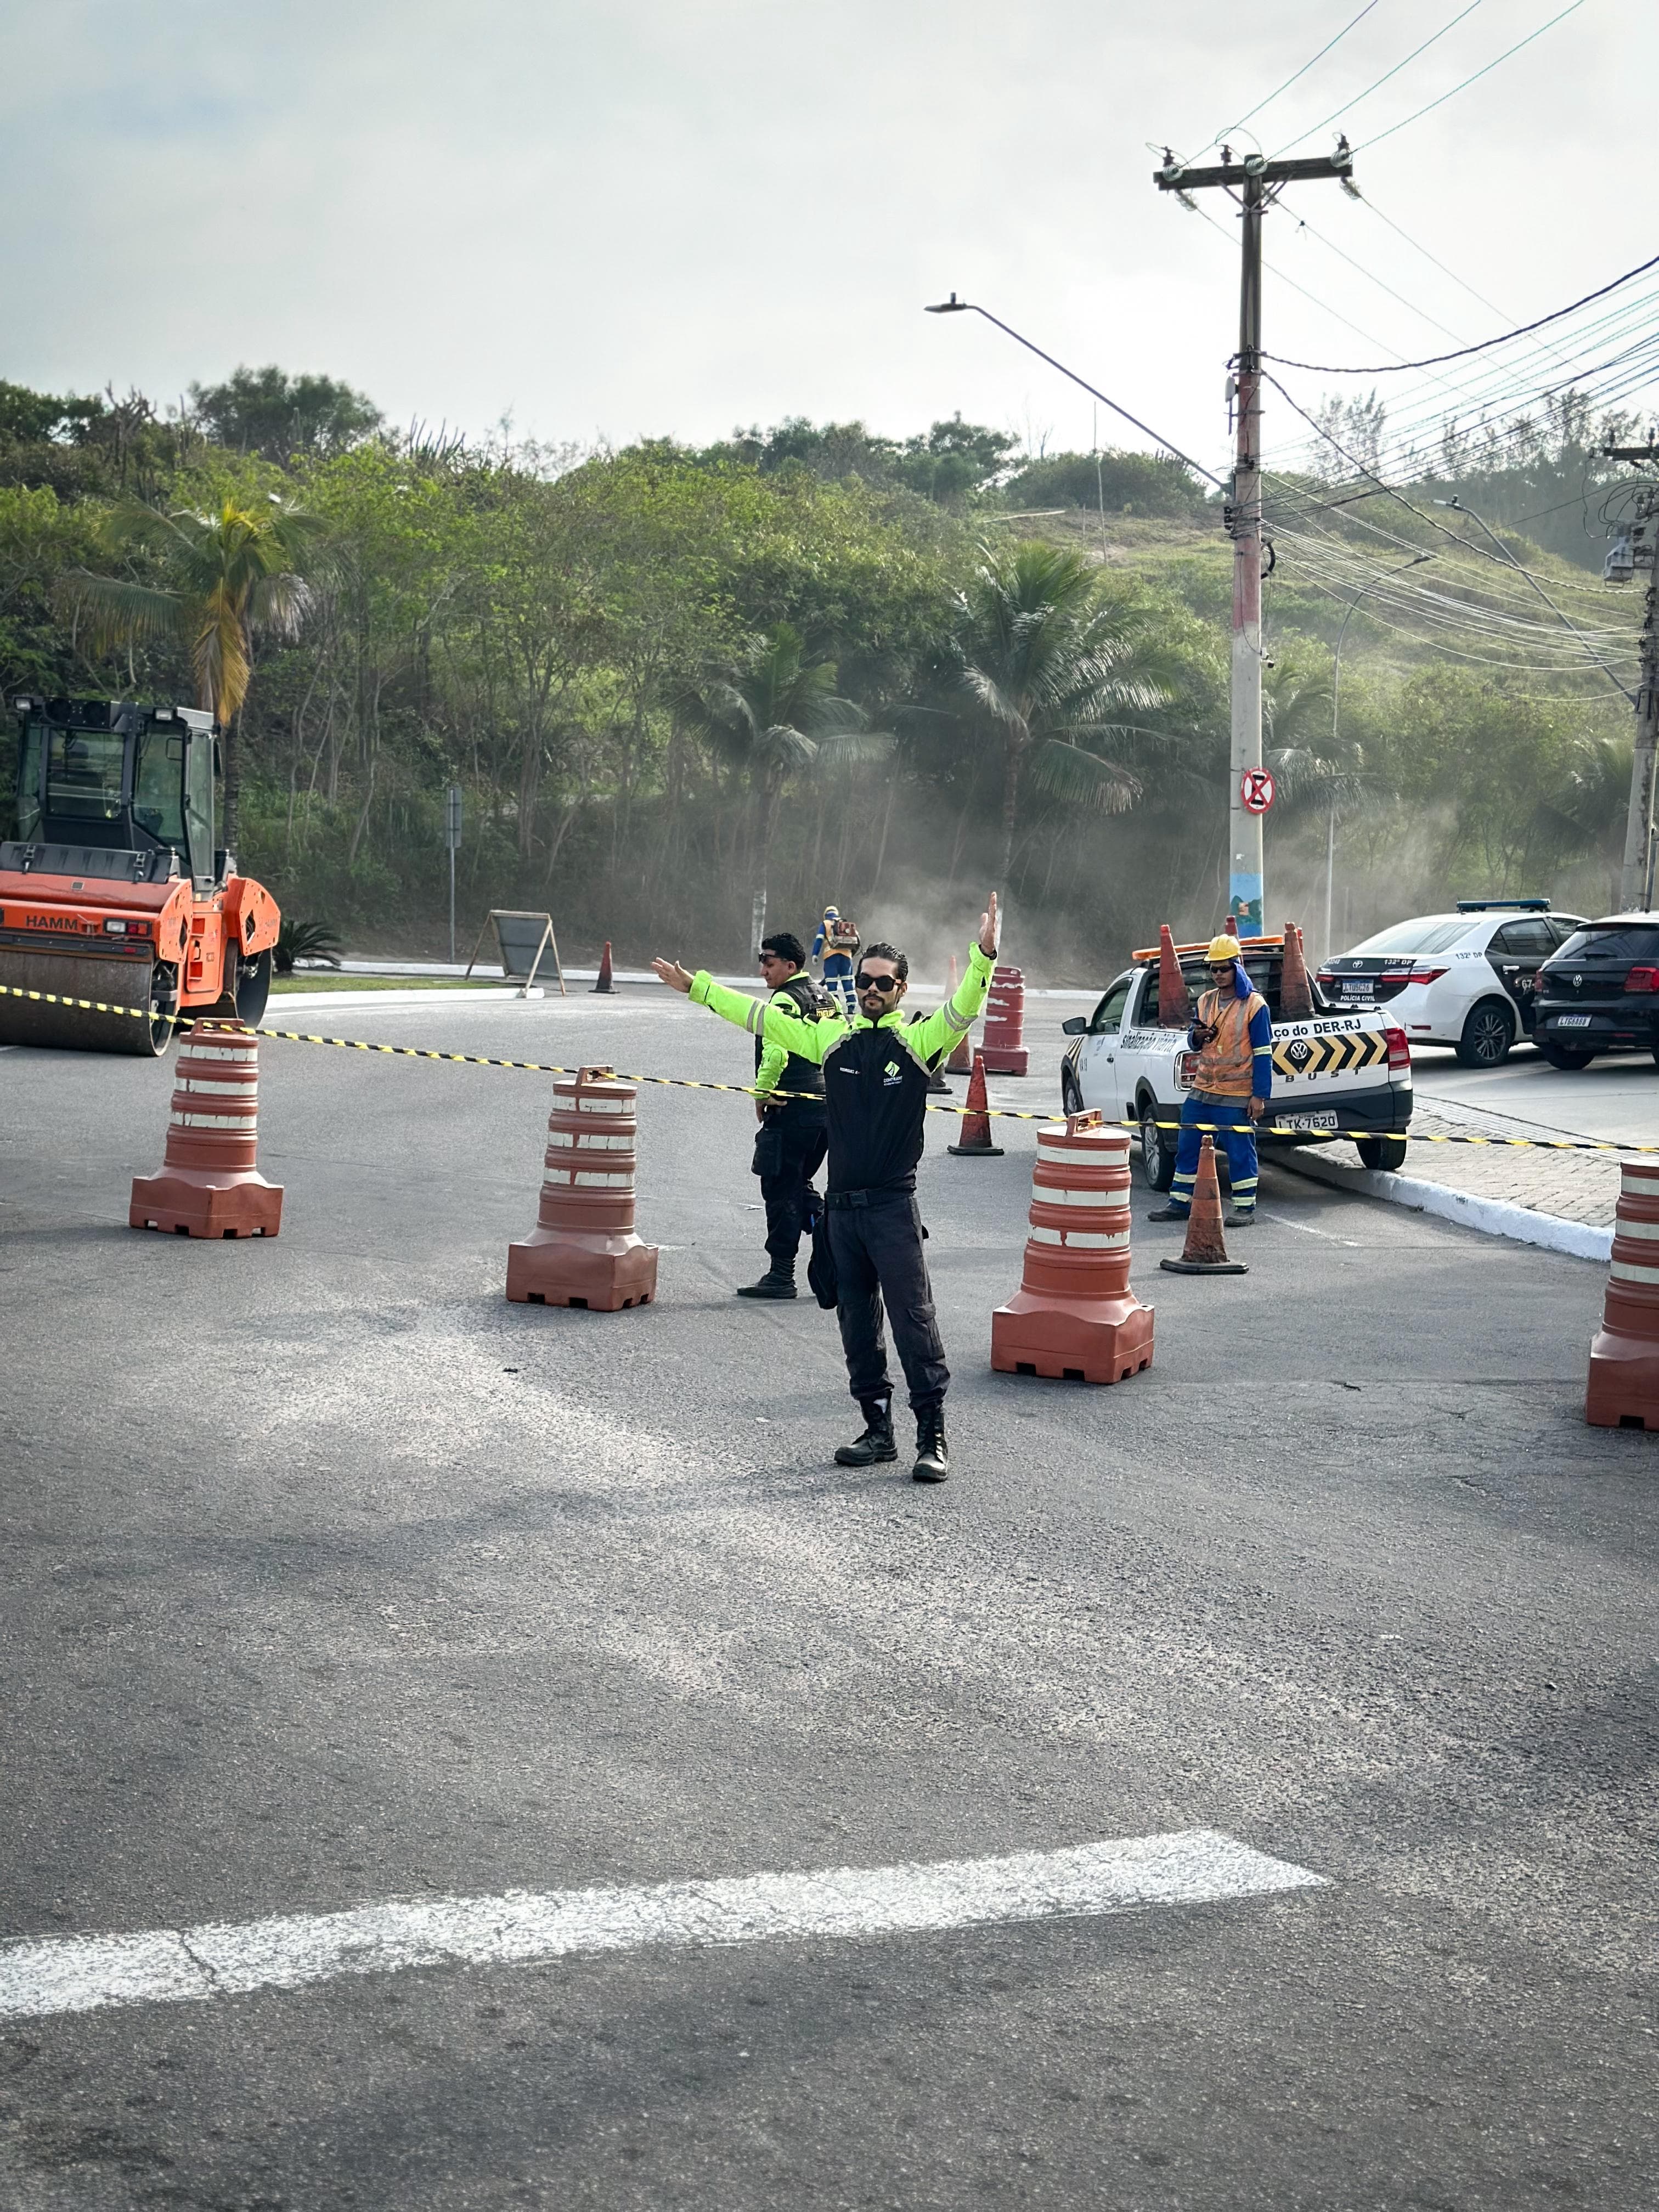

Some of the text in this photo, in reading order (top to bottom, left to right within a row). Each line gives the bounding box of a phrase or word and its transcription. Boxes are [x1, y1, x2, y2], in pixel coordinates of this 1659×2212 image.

[26, 916, 78, 930] HAMM
[1293, 1025, 1308, 1036] do
[1314, 1019, 1361, 1034] DER-RJ
